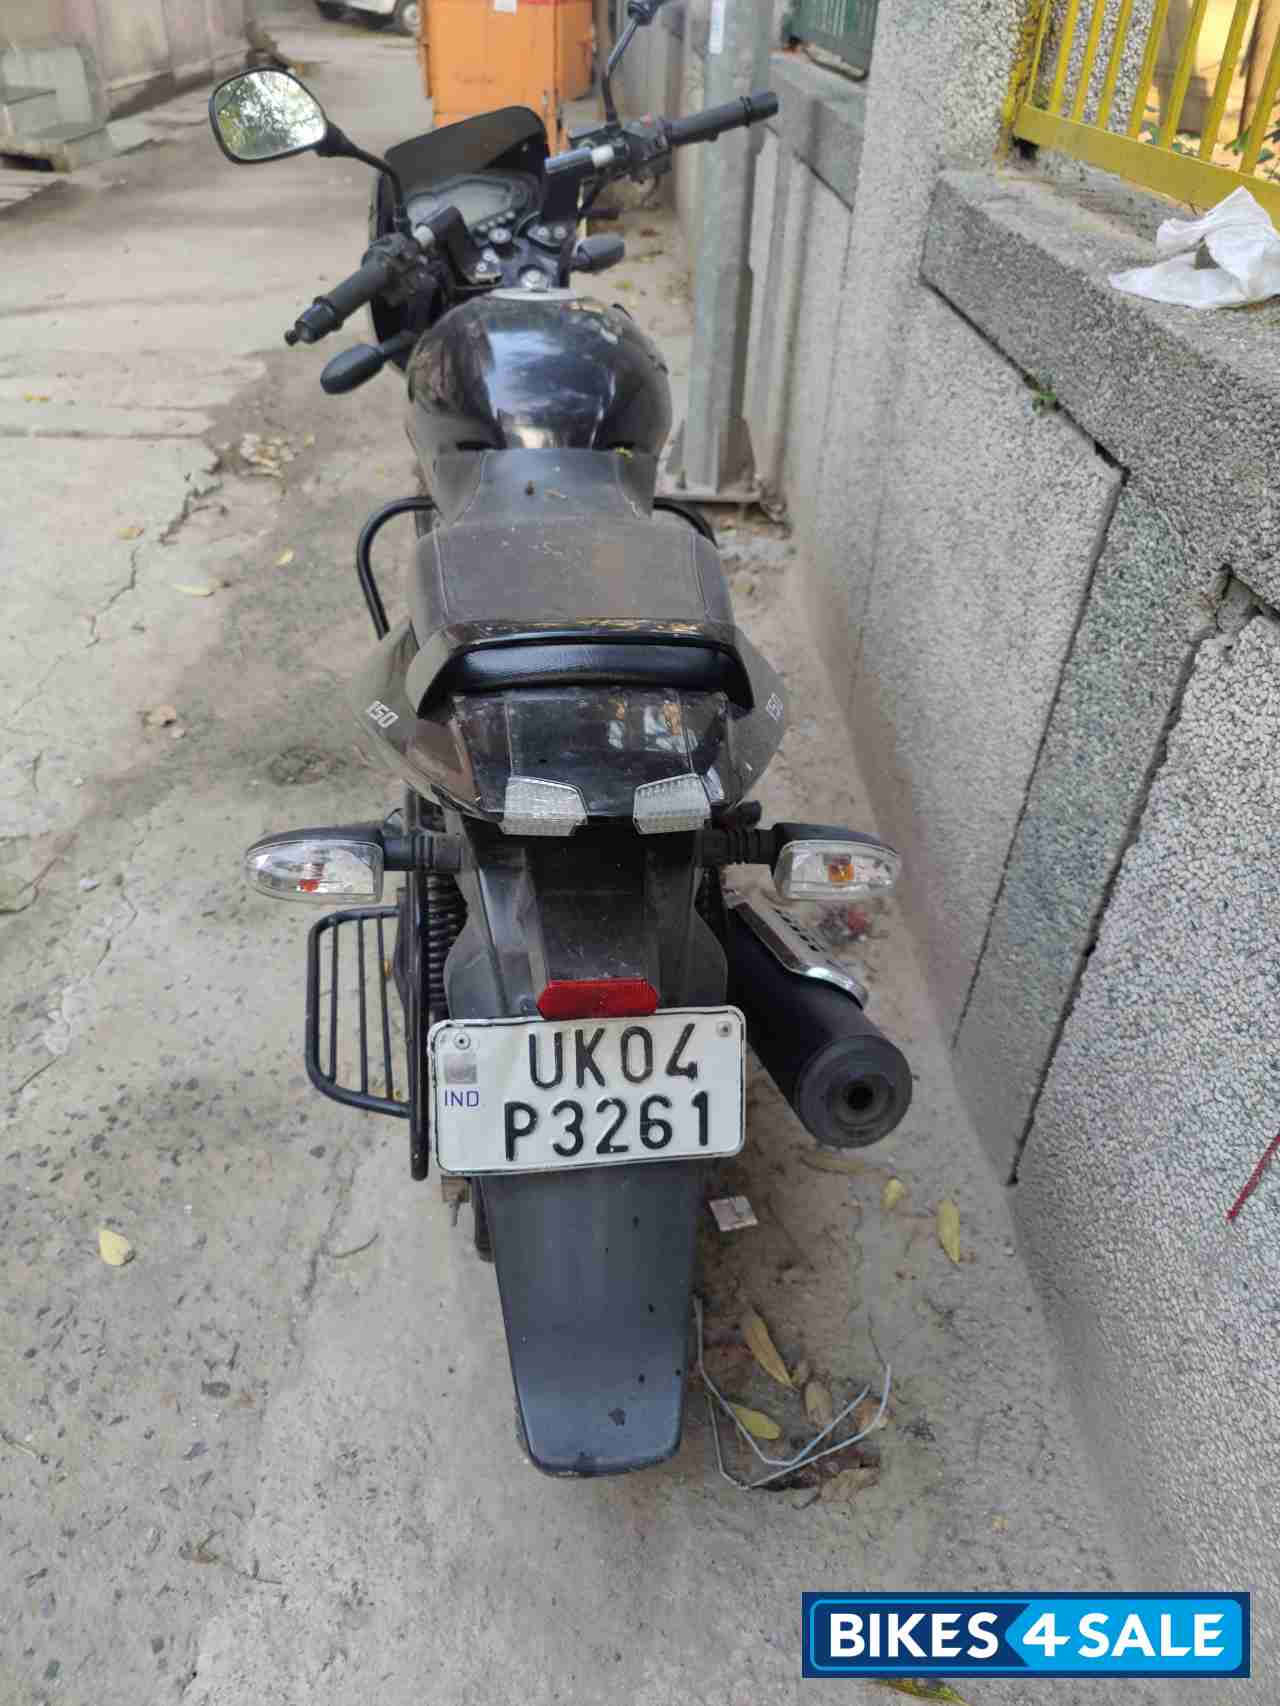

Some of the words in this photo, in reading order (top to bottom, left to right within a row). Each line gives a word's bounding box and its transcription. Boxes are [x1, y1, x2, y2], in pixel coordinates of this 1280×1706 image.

[366, 700, 399, 728] 150
[444, 1089, 479, 1107] IND
[504, 1091, 709, 1161] P3261
